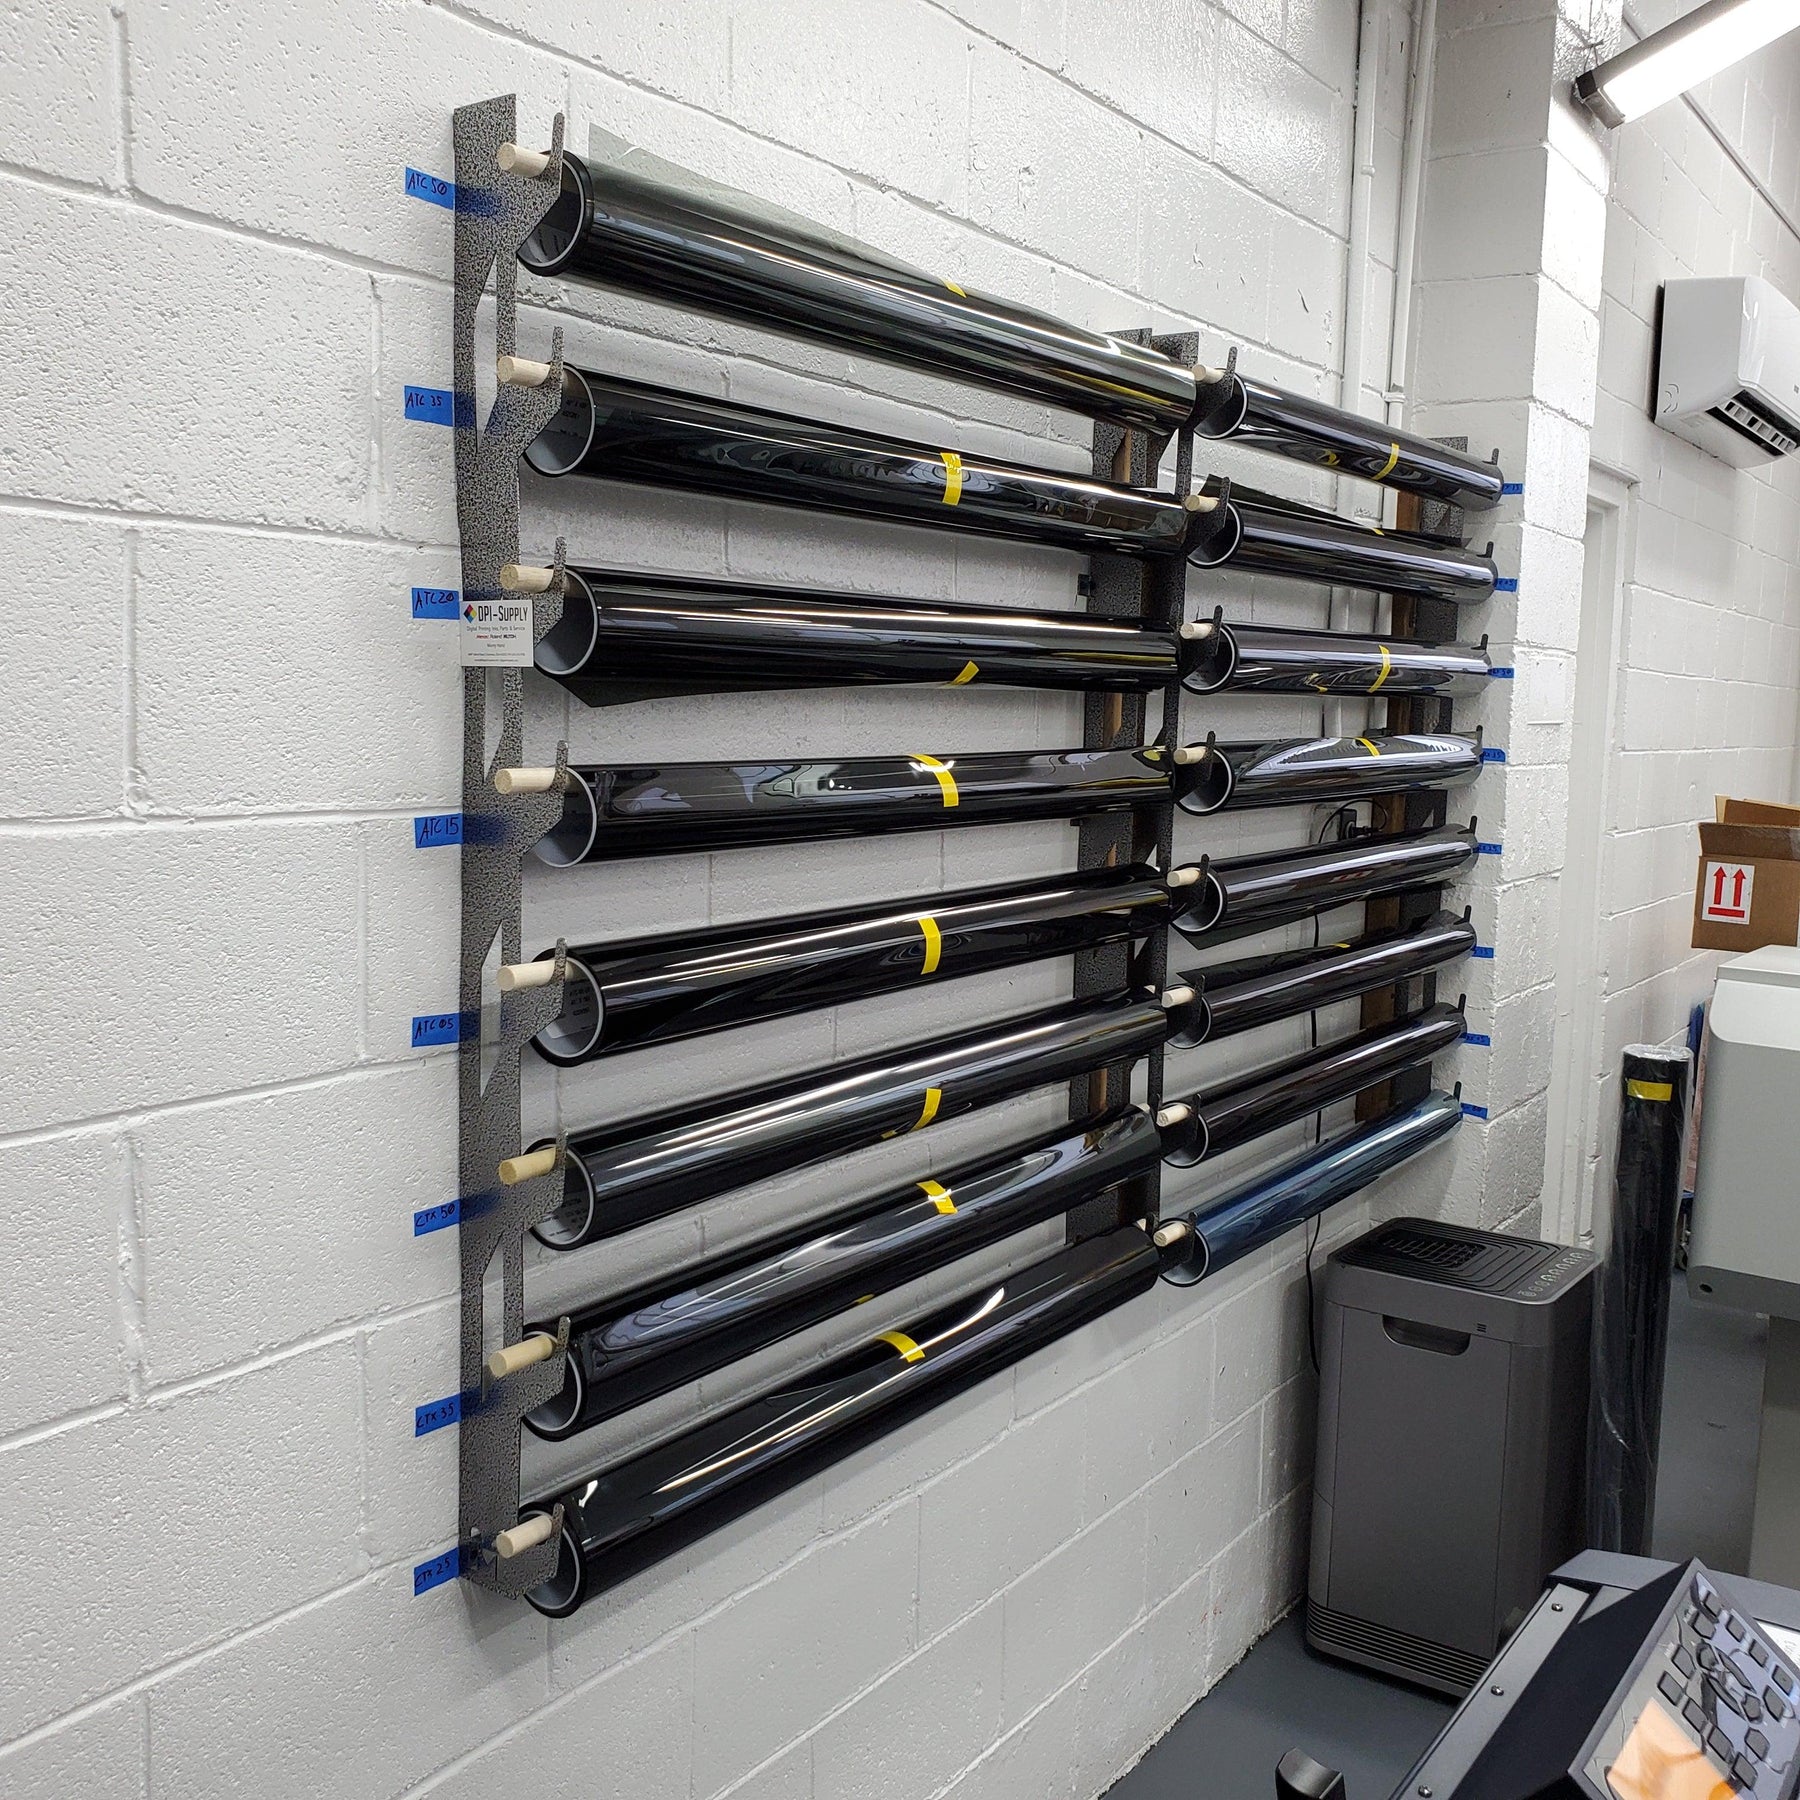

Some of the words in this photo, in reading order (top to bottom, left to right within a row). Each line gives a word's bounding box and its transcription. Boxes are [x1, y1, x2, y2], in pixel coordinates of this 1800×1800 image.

[408, 172, 428, 190] ATC
[431, 177, 448, 195] 50
[406, 392, 425, 408] ATC
[430, 395, 442, 407] 35
[419, 818, 441, 845] ATC
[445, 816, 459, 835] 15
[414, 1019, 436, 1040] ATC
[439, 1018, 454, 1030] 05
[415, 1211, 436, 1227] CTX
[440, 1203, 455, 1219] 50
[416, 1411, 437, 1428] CTX
[441, 1402, 454, 1419] 35
[415, 1569, 433, 1588] CTX
[436, 1557, 450, 1575] 25
